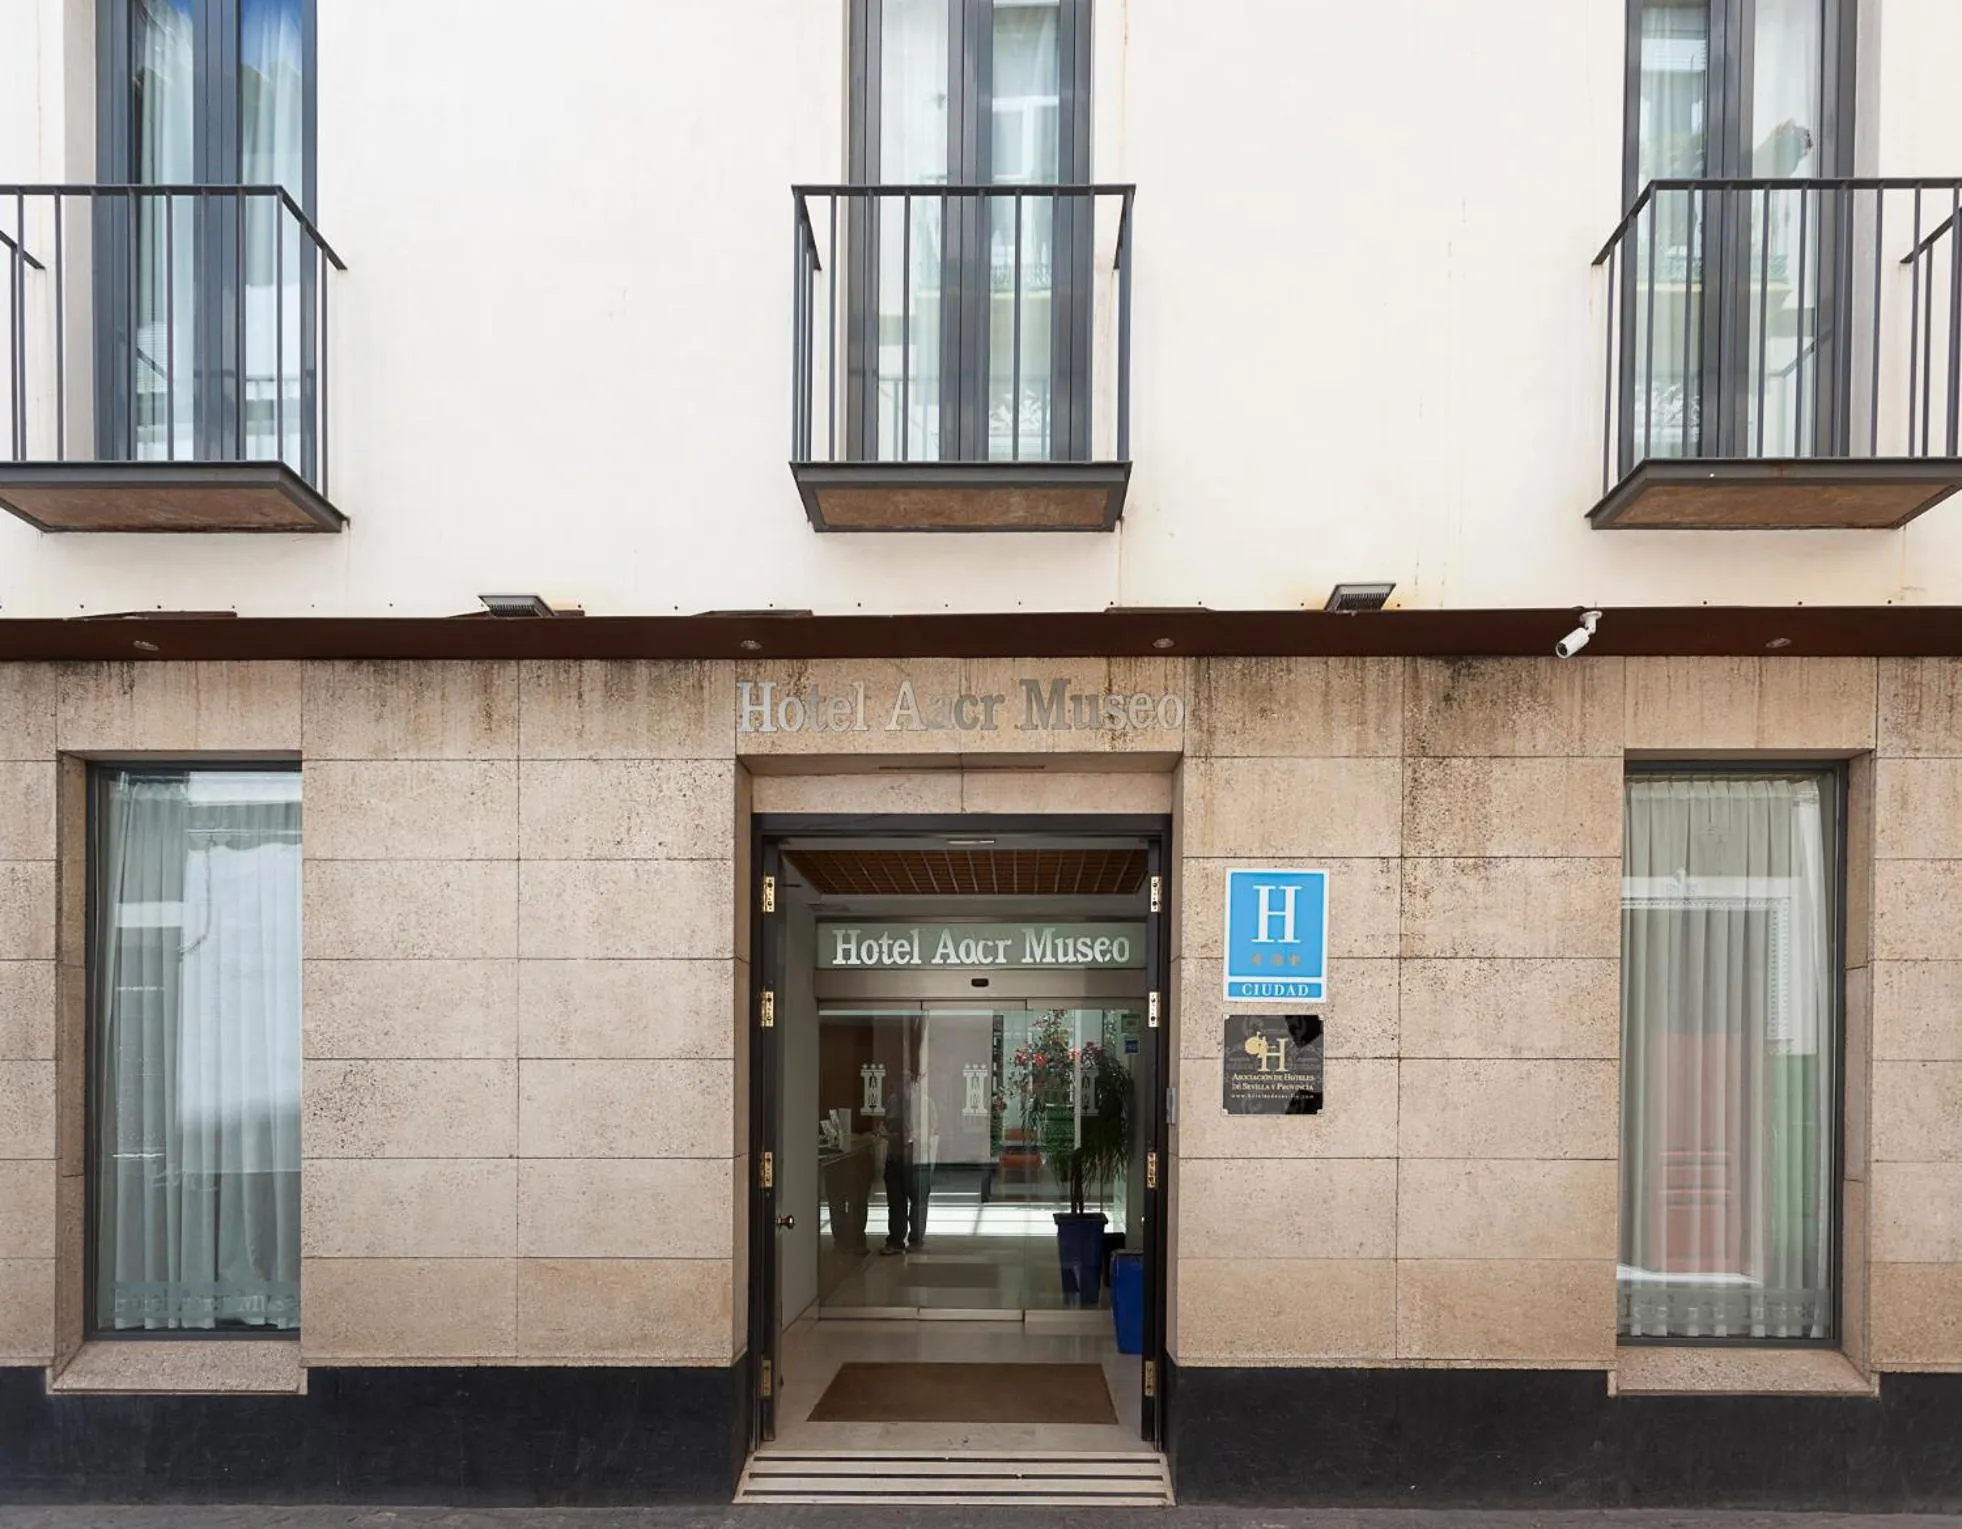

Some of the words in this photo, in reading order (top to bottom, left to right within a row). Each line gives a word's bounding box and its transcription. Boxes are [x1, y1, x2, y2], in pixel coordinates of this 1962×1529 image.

[736, 680, 869, 732] Hotel
[1019, 678, 1185, 731] Museo
[1250, 884, 1303, 944] H
[832, 928, 922, 965] Hotel
[1021, 927, 1130, 964] Museo
[1241, 983, 1309, 996] CIUDAD
